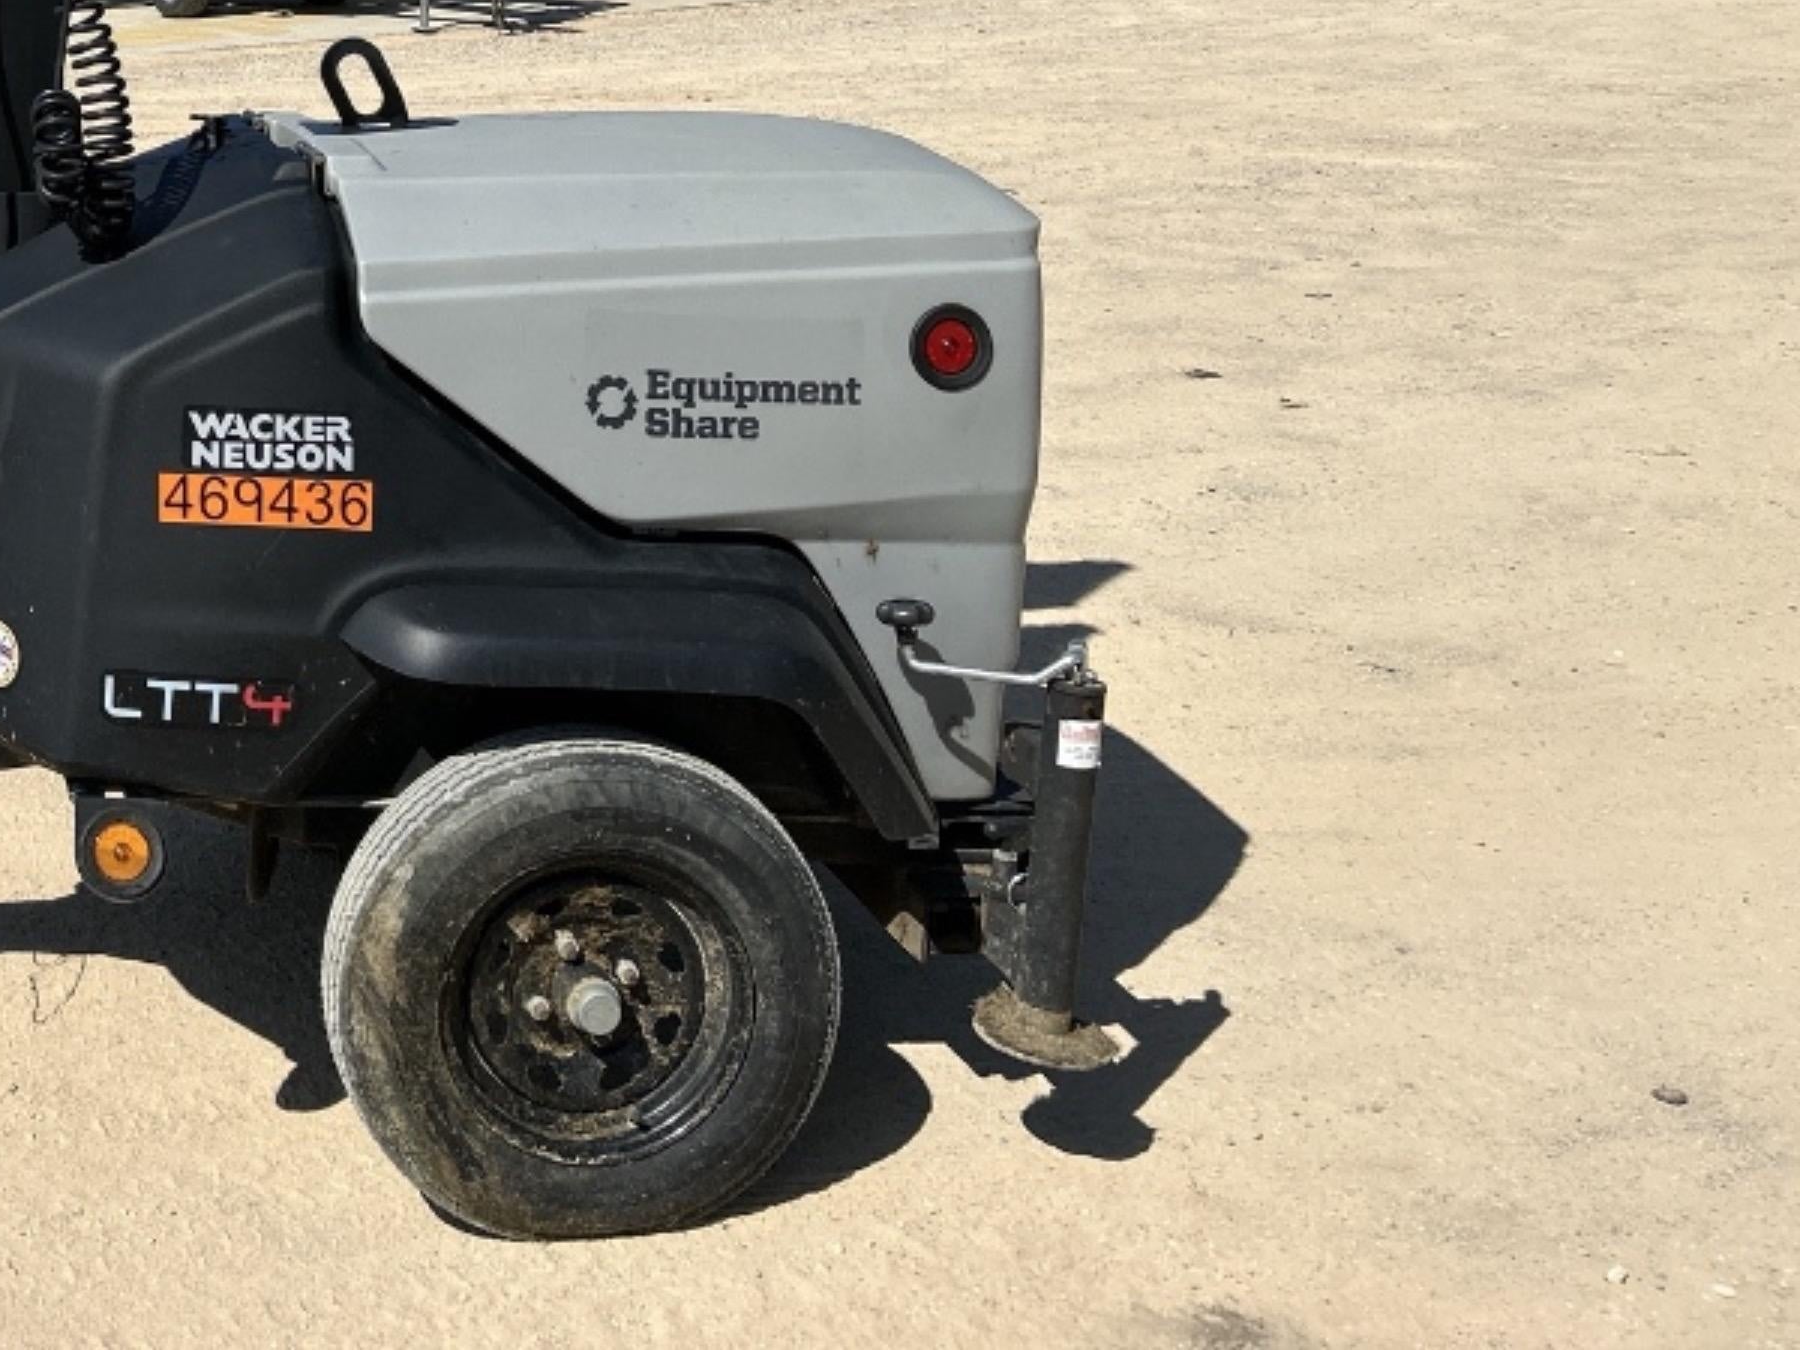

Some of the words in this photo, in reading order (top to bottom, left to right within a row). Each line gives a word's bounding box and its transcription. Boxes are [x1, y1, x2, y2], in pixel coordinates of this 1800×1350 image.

[645, 368, 862, 409] Equipment
[188, 410, 353, 442] WACKER
[644, 407, 760, 440] Share
[190, 440, 355, 472] NEUSON
[163, 473, 369, 527] 469436
[104, 674, 292, 726] LTT4
